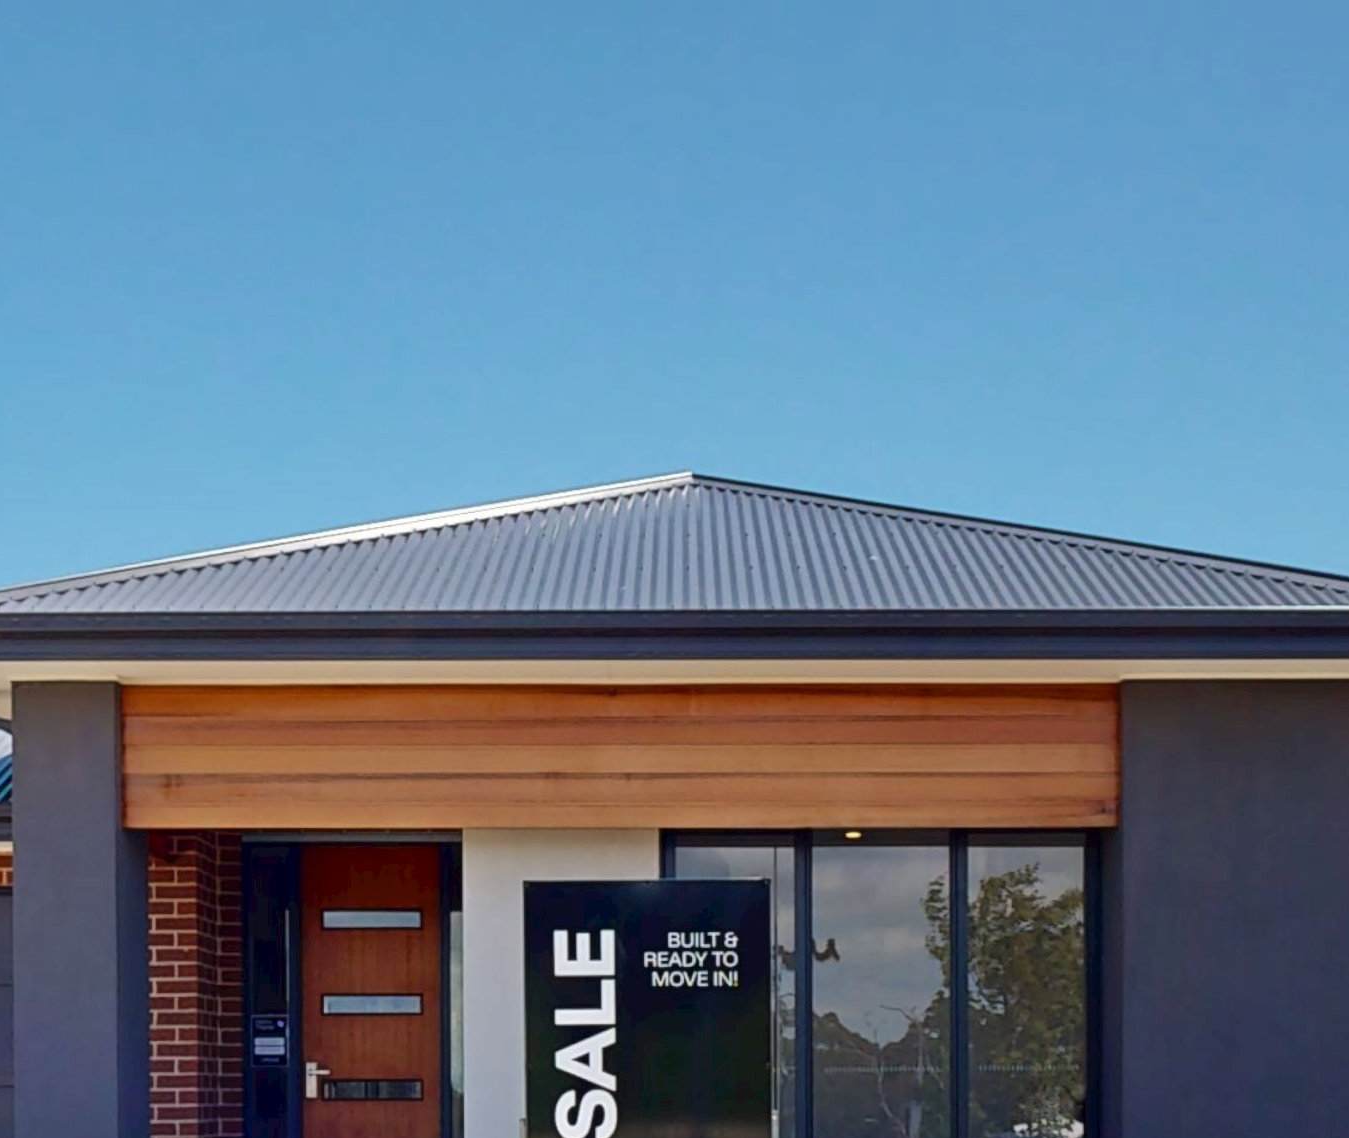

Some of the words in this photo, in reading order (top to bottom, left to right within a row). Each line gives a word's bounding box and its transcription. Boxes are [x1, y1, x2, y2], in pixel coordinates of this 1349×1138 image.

[667, 932, 721, 948] BUILT
[723, 932, 739, 948] &
[643, 951, 708, 968] READY
[711, 950, 739, 967] TO
[651, 971, 709, 987] MOVE
[713, 971, 739, 987] IN!
